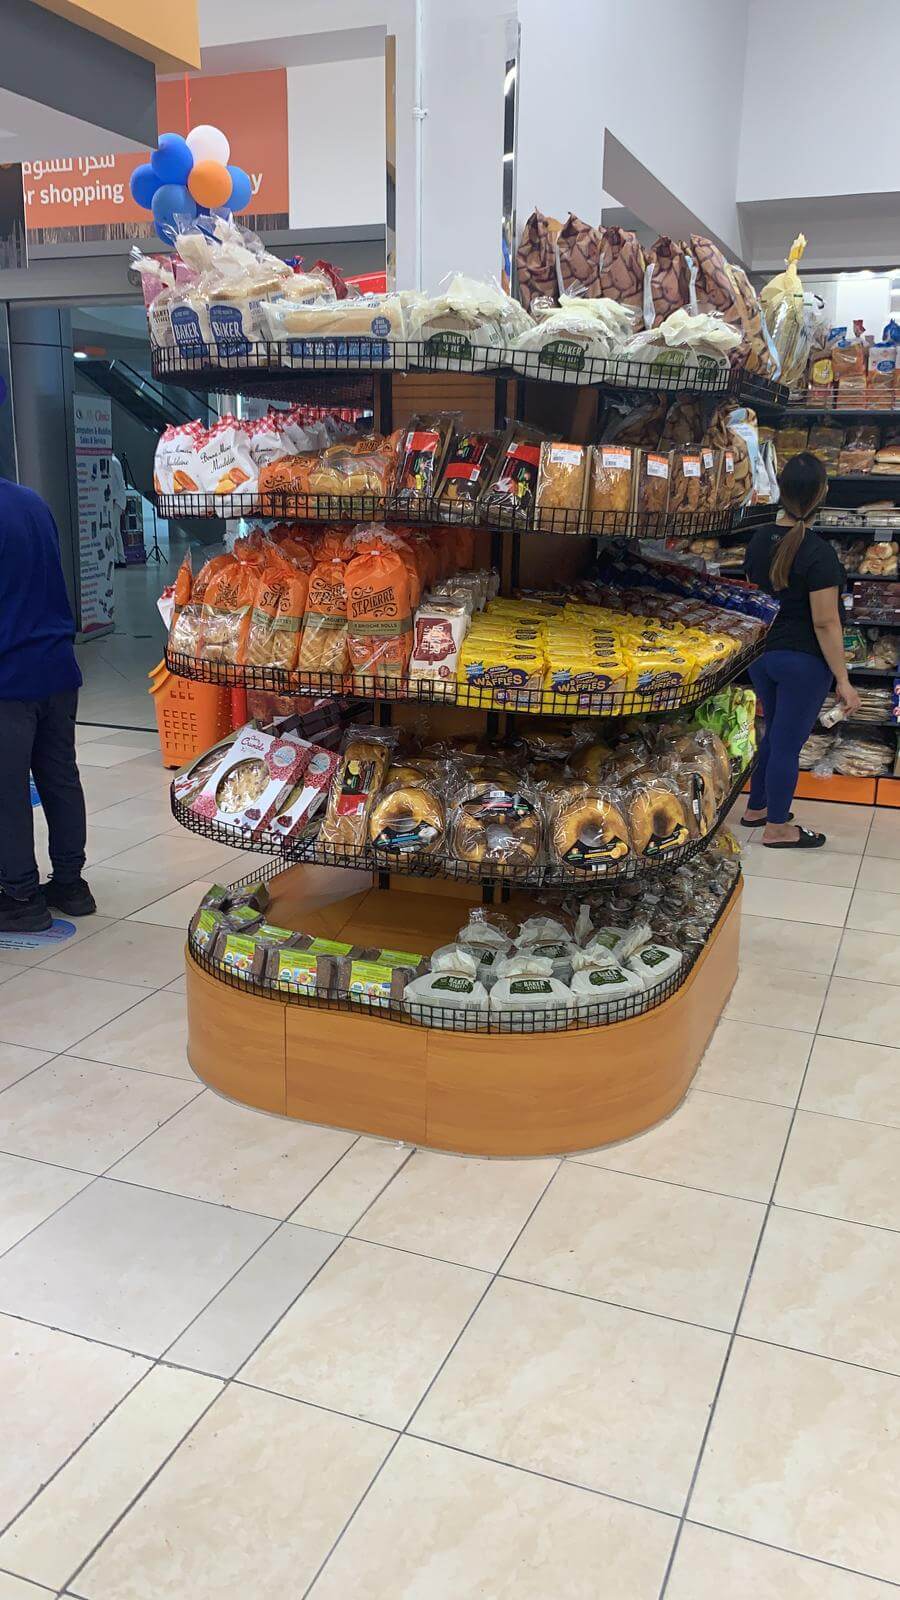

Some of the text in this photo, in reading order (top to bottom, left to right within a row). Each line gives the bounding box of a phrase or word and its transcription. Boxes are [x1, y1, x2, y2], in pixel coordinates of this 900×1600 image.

[40, 180, 124, 206] shopping
[173, 321, 200, 340] BAKER
[211, 321, 243, 338] BAKER
[557, 343, 583, 357] BAKER
[473, 674, 523, 687] WAFFLES
[557, 681, 606, 693] WAFFLES
